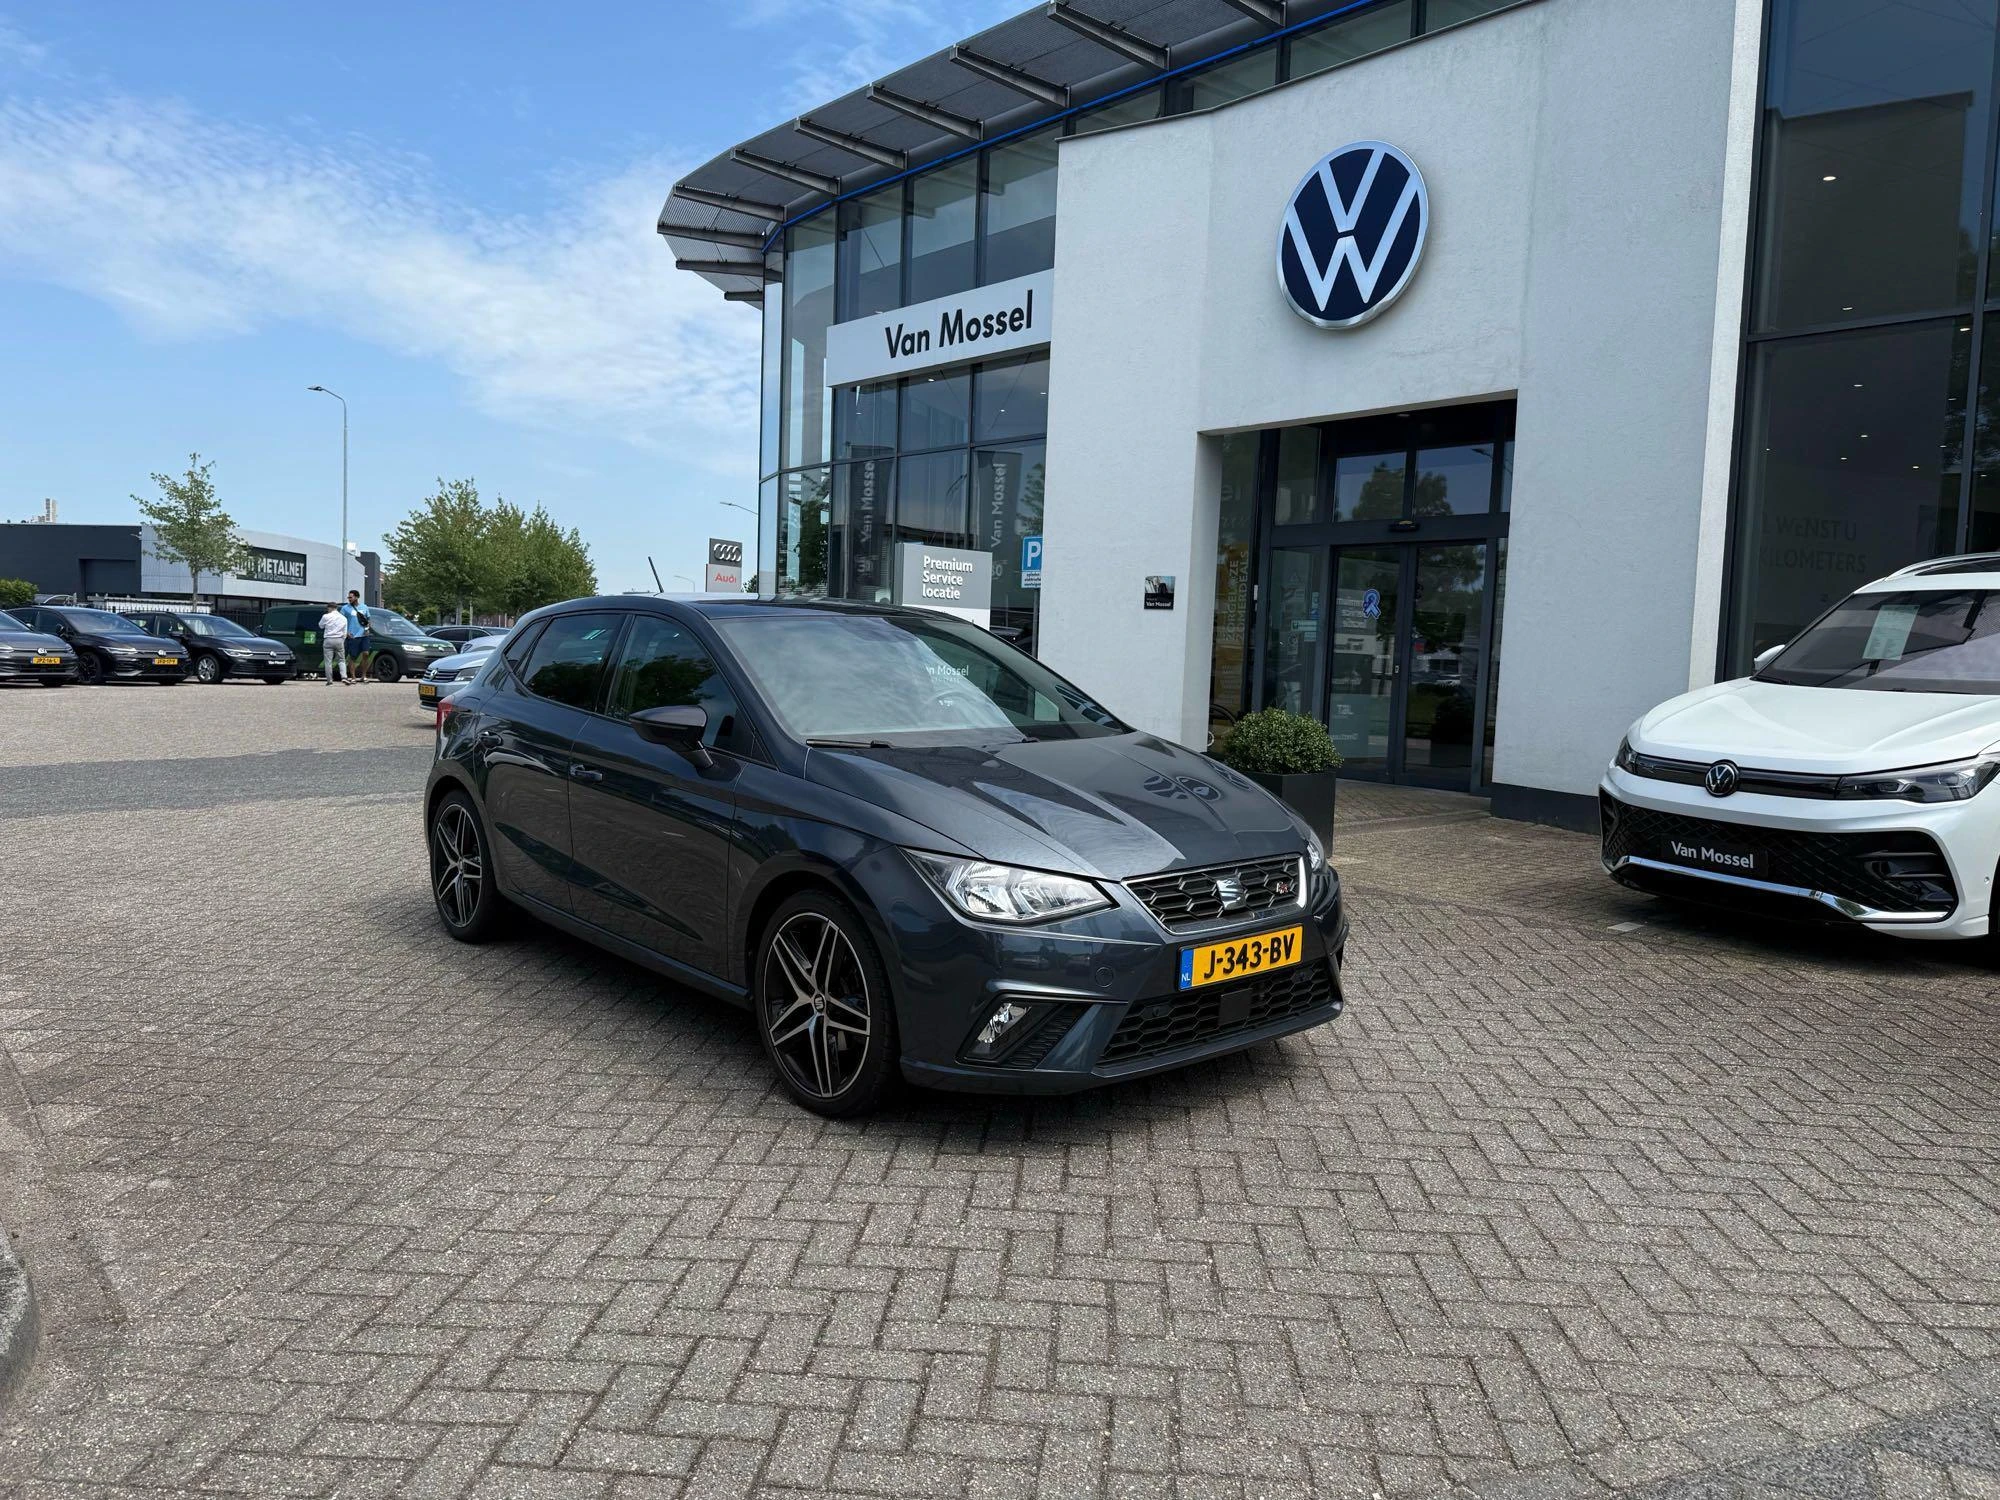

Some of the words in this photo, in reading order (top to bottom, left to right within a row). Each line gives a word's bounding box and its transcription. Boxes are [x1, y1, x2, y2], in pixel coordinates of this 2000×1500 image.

[884, 323, 931, 359] Van
[939, 288, 1034, 348] Mossel
[860, 461, 875, 511] Mosse
[991, 463, 1007, 515] Mossel
[991, 520, 1003, 548] Van
[1844, 520, 1857, 542] U
[923, 555, 973, 573] Premium
[1027, 541, 1042, 568] P
[257, 556, 305, 578] METALNET
[715, 572, 737, 584] Audi
[922, 570, 964, 586] Service
[922, 583, 961, 600] locatie
[937, 665, 969, 676] Mossel
[1671, 840, 1697, 859] Van
[1701, 846, 1754, 869] Mossel
[1203, 932, 1295, 980] J-343-BV
[1181, 973, 1191, 983] NL
